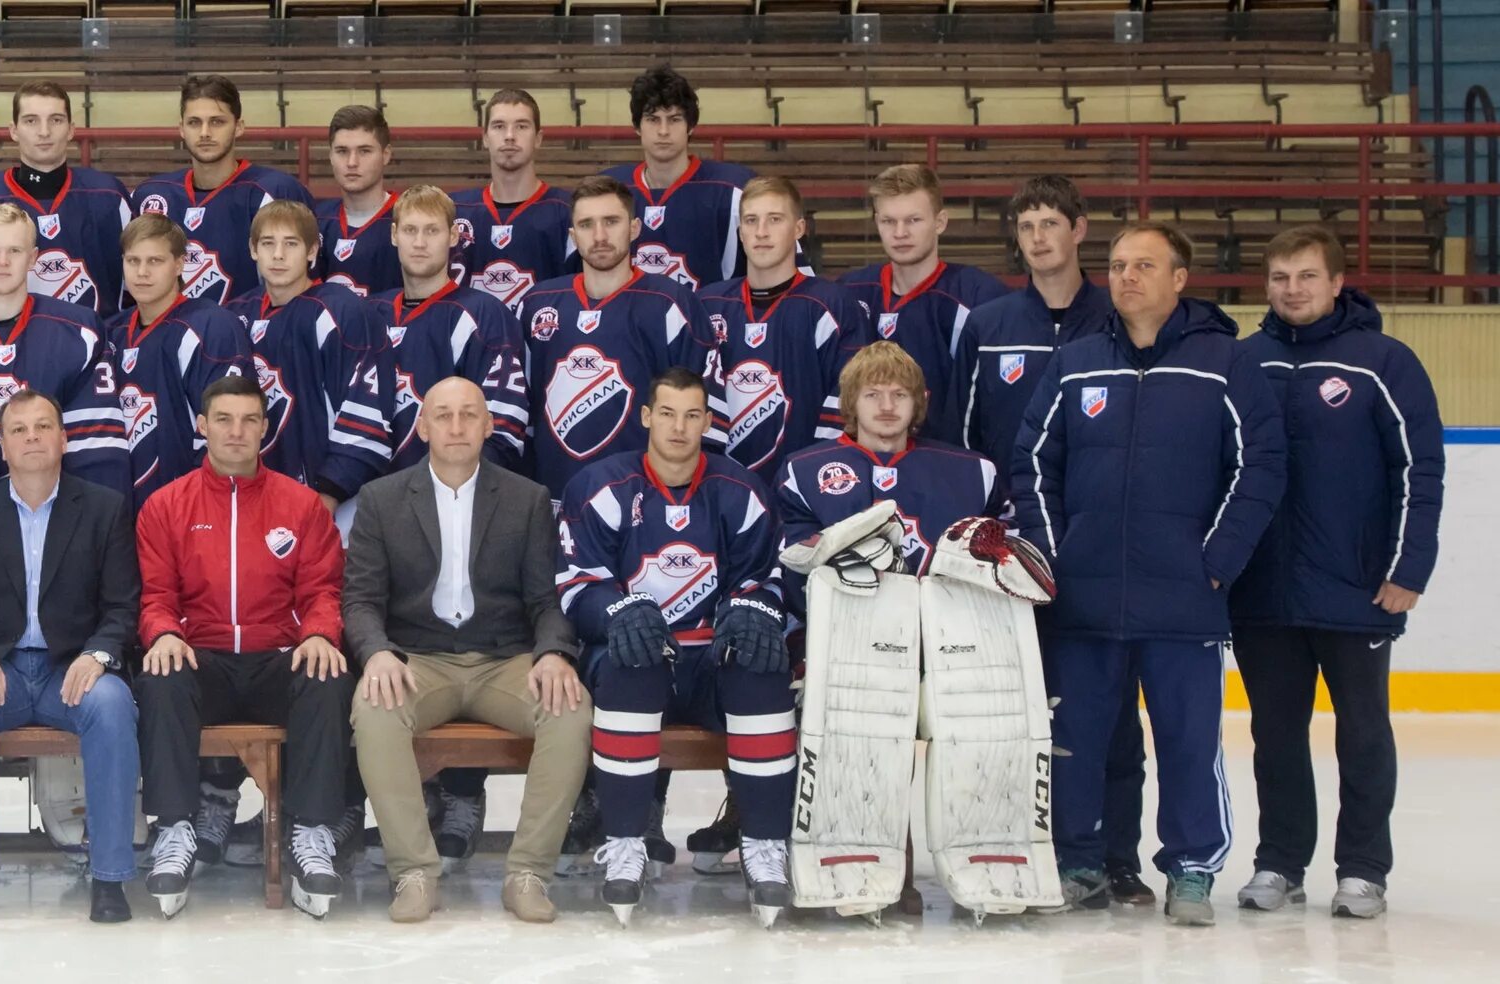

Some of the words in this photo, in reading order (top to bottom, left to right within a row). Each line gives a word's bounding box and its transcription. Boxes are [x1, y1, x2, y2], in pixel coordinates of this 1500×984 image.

[148, 201, 160, 210] 70
[41, 259, 67, 272] ХК
[641, 254, 667, 265] ХК
[488, 270, 513, 283] ХК
[541, 313, 553, 323] 70
[571, 357, 597, 371] ХК
[739, 372, 763, 383] ХК
[557, 379, 621, 436] КРИСТАЛЛ
[727, 392, 782, 447] РИСТАЛЛ
[828, 467, 842, 477] 70
[666, 554, 692, 567] ХК
[664, 575, 718, 619] ИСТАЛЛ
[730, 597, 783, 624] Reebok
[796, 746, 818, 834] CCM
[1034, 752, 1050, 832] CCM
